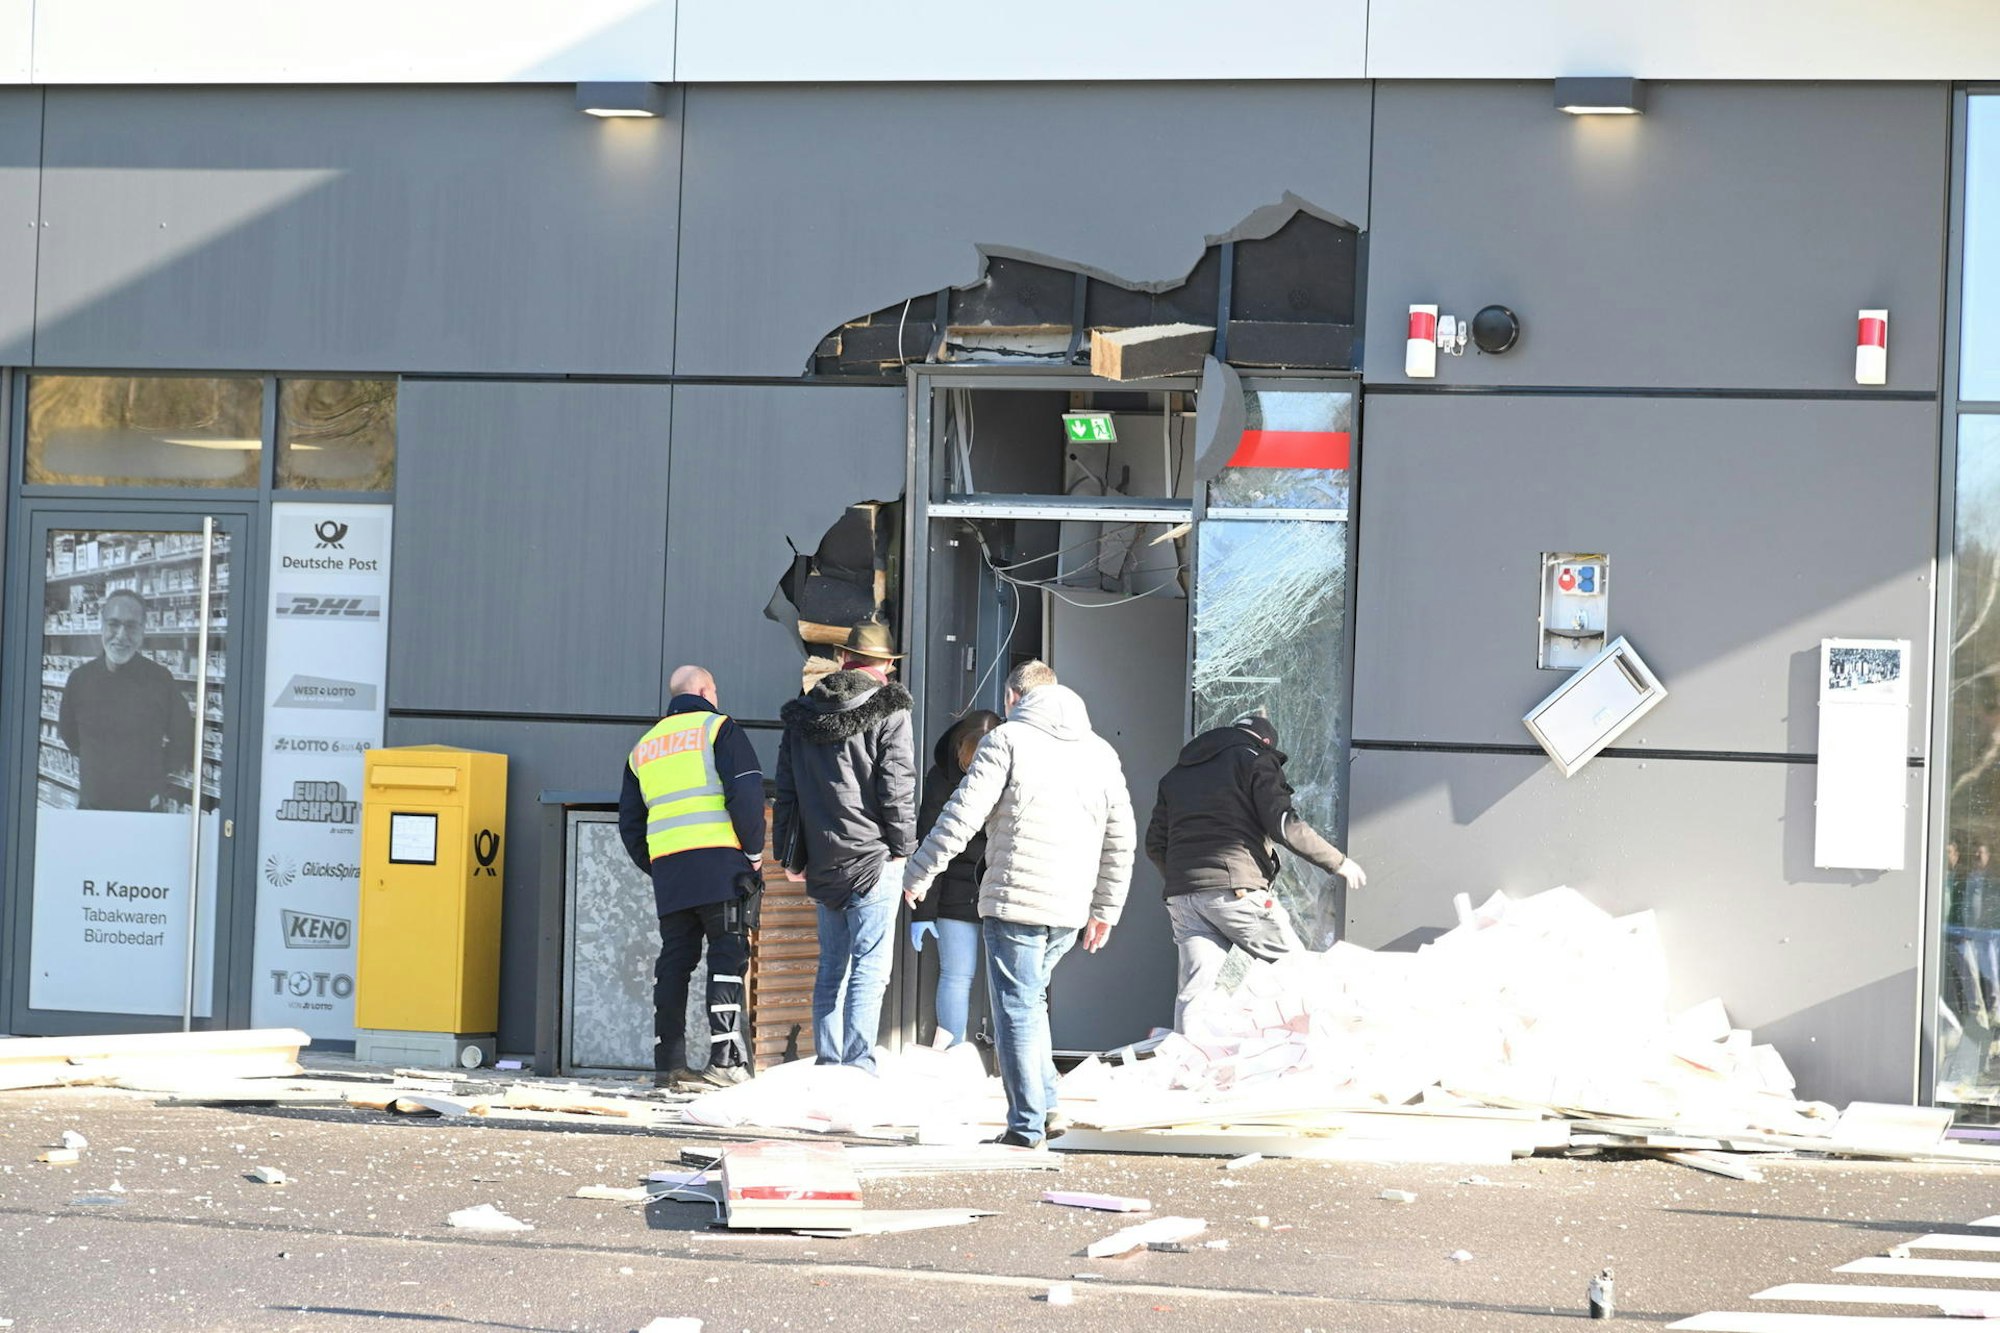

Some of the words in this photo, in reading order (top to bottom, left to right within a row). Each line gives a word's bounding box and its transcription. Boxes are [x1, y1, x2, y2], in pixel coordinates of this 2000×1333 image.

[282, 556, 344, 570] Deutsche
[348, 557, 378, 571] Post
[291, 597, 363, 616] DHL
[326, 687, 356, 697] LOTTO
[291, 739, 329, 752] LOTTO
[331, 741, 340, 752] 6
[637, 727, 704, 766] POLIZEI
[293, 780, 343, 802] EURO
[276, 799, 359, 824] JACKPOT
[302, 861, 361, 880] GlücksSpira
[82, 880, 100, 896] R.
[106, 881, 170, 902] Kapoor
[82, 906, 167, 924] Tabakwaren
[84, 928, 164, 946] Bürobedarf
[290, 916, 348, 940] KENO
[270, 970, 353, 999] TOTO
